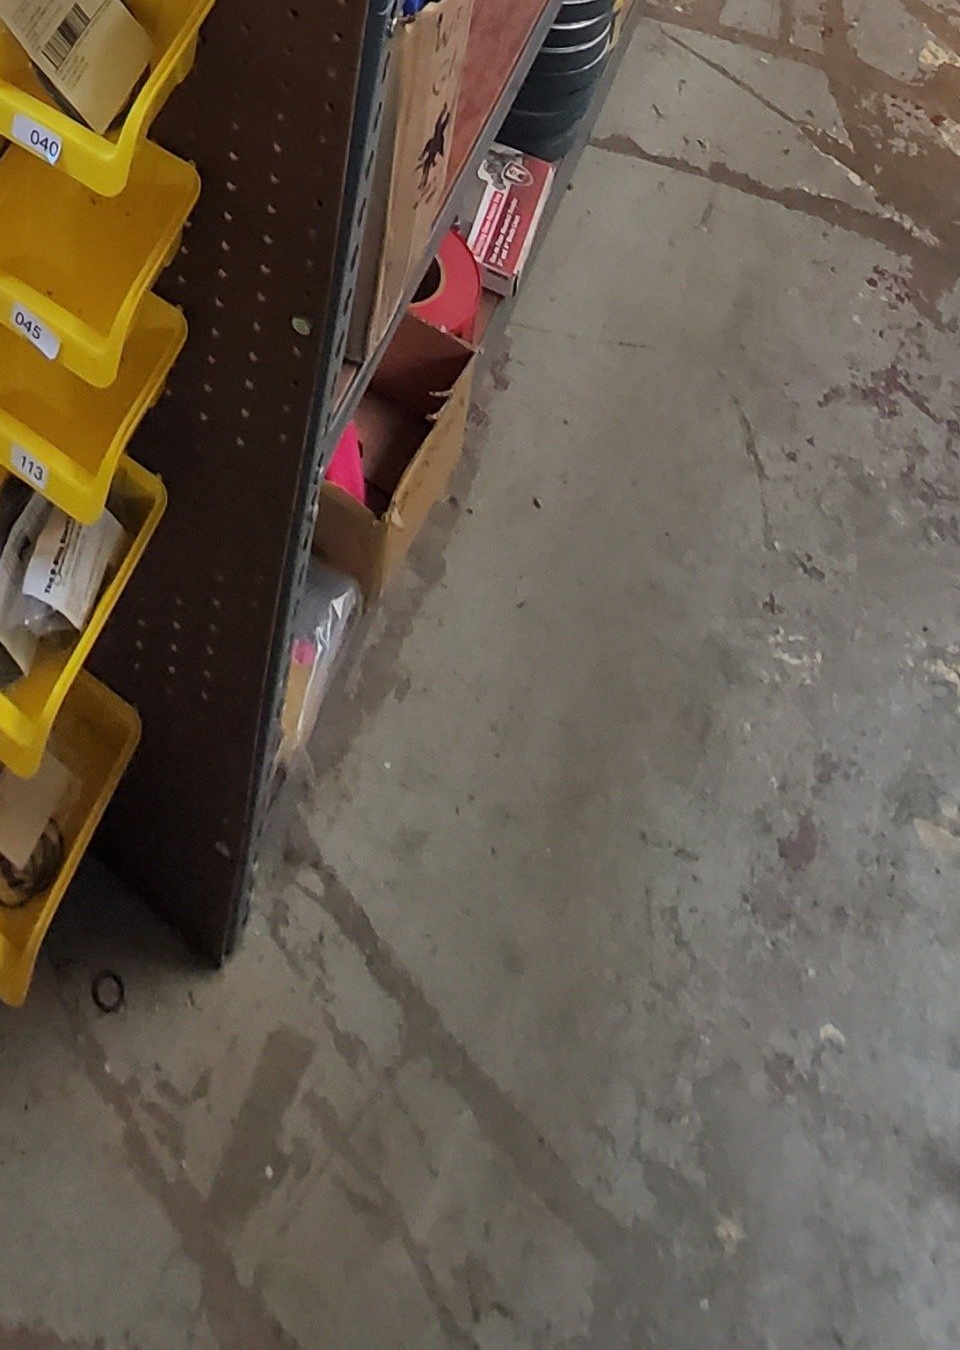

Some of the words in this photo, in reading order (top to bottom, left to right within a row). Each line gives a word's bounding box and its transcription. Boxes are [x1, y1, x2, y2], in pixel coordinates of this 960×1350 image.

[29, 129, 60, 159] 040
[14, 310, 42, 341] 045
[18, 454, 44, 482] 113
